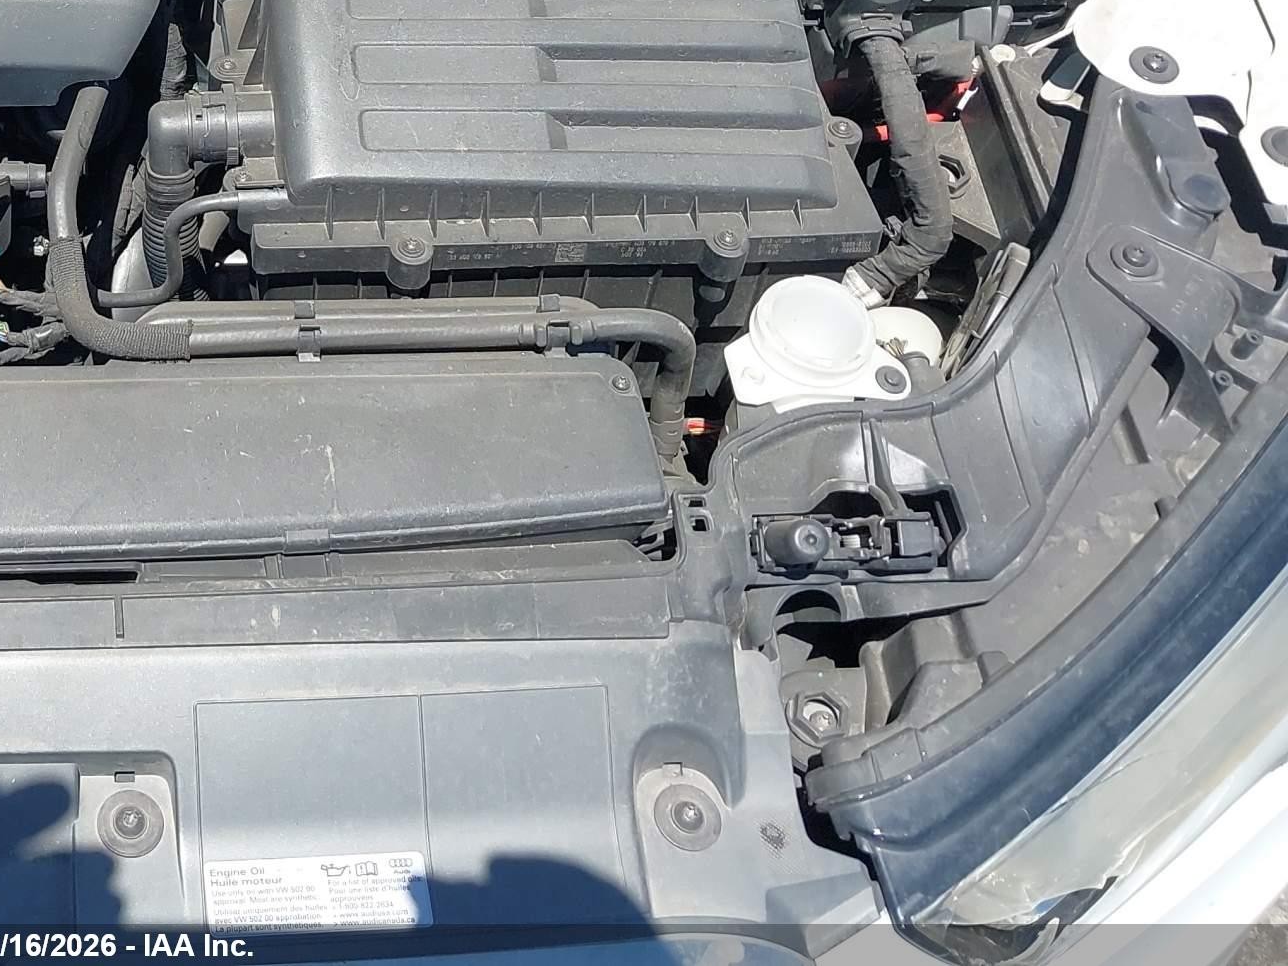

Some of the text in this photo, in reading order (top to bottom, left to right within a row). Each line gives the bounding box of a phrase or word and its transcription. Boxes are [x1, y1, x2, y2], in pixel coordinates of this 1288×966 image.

[209, 867, 265, 878] Engine Oil
[211, 878, 282, 887] Huile moteur
